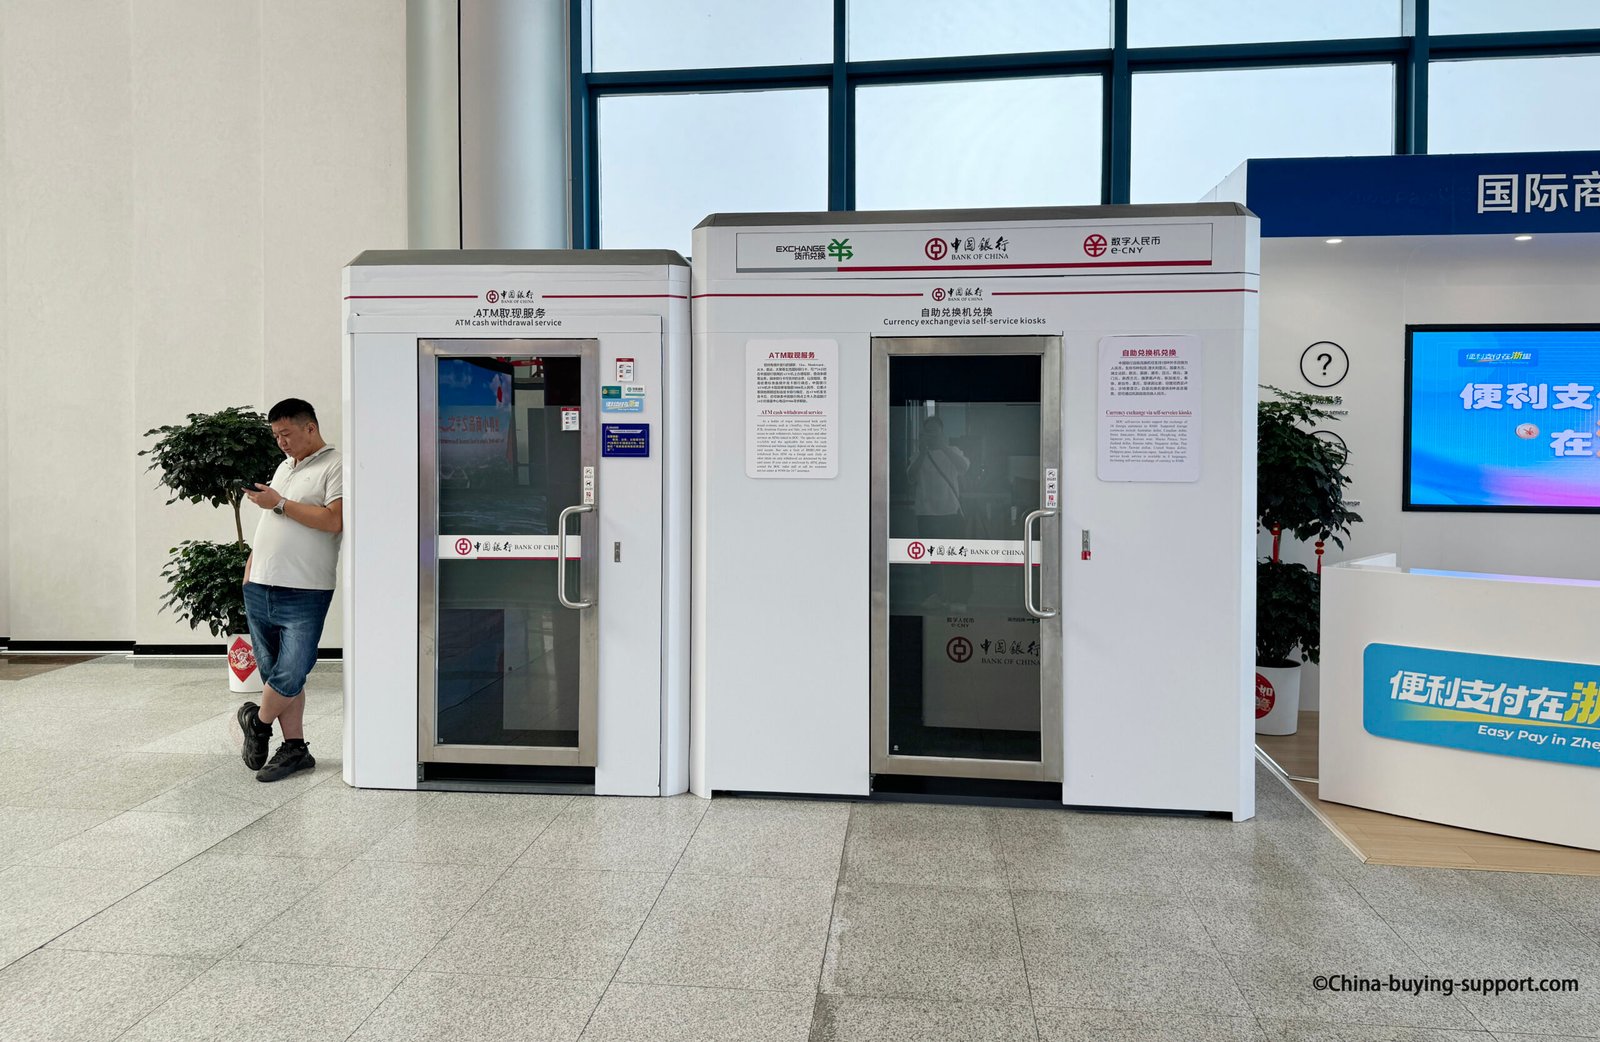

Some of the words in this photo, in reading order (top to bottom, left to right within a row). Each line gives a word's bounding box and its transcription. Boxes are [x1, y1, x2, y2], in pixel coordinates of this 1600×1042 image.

[1477, 170, 1600, 213] 国际商
[1111, 236, 1160, 246] 数字人民币
[794, 252, 826, 260] 货币兑换
[475, 308, 546, 318] ATM取现服务
[921, 307, 993, 317] 自助兑换机兑换
[883, 318, 919, 327] Currency
[920, 318, 971, 326] exchangevia
[971, 317, 1019, 325] self-service
[1122, 349, 1177, 357] 自助兑换机兑换
[1460, 382, 1600, 410] 便利支
[1550, 429, 1600, 457] 在
[1477, 724, 1514, 741] Easy
[1517, 730, 1549, 745] Pay
[1551, 733, 1566, 746] in
[1570, 736, 1600, 753] Zhe
